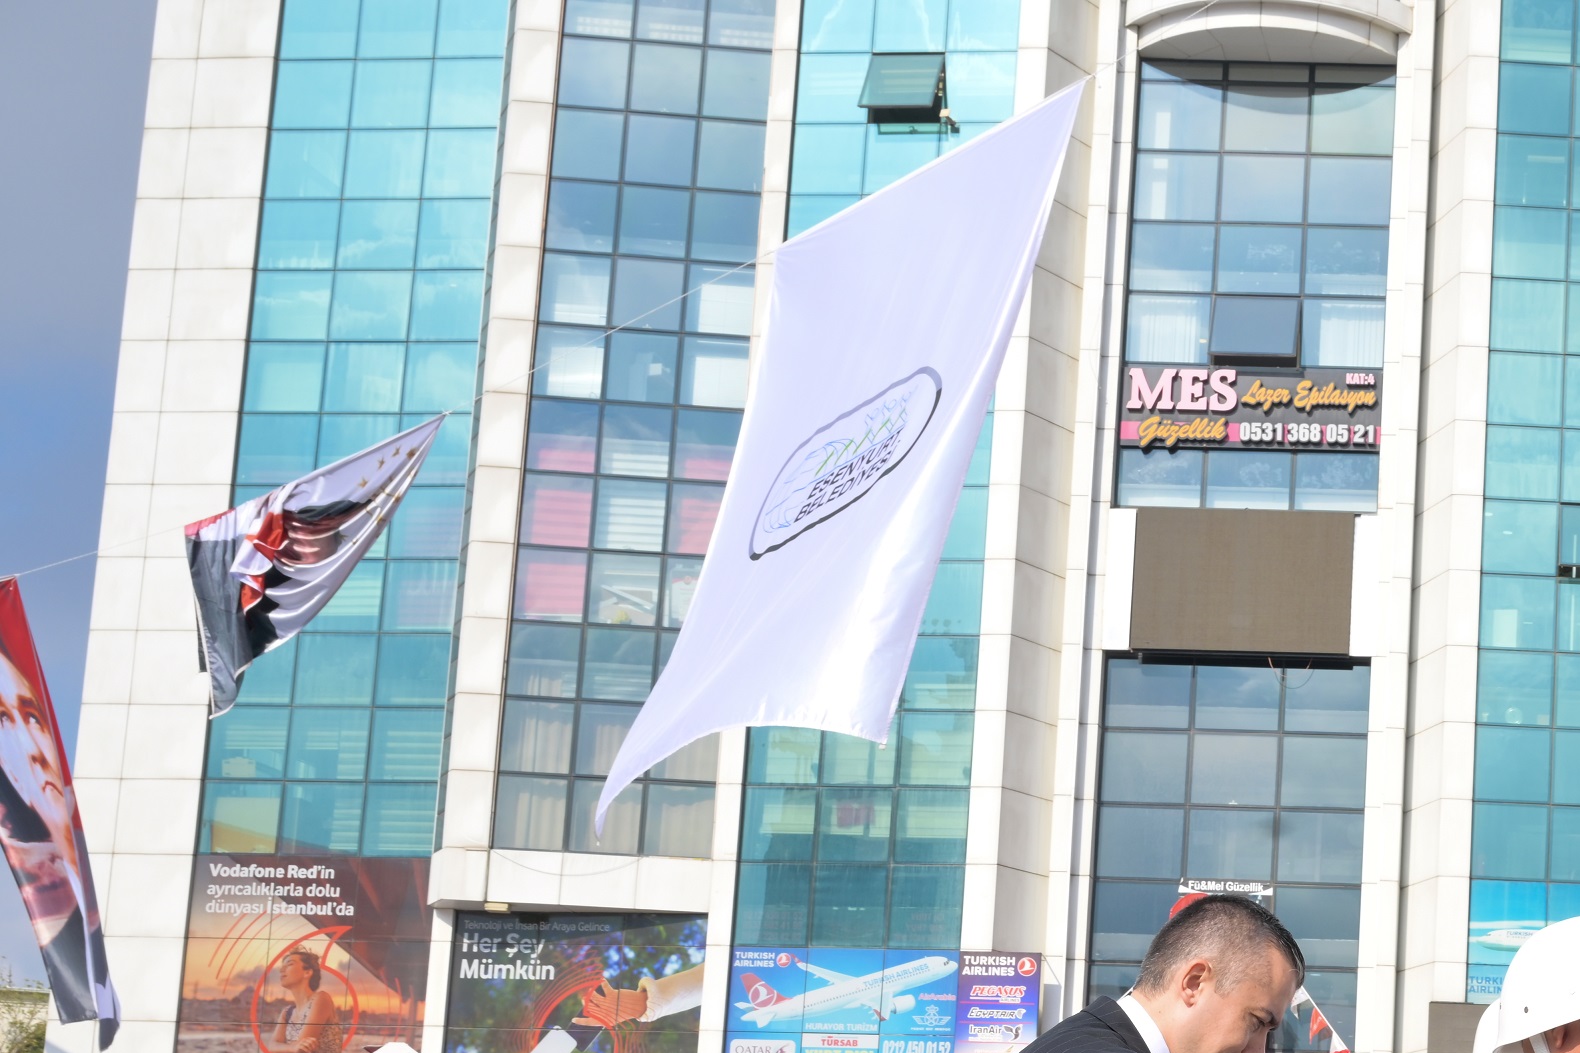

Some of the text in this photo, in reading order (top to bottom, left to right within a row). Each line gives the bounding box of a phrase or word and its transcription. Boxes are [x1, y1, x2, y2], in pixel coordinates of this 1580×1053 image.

[1345, 373, 1375, 385] KAT:4
[1126, 367, 1238, 411] MES
[1242, 380, 1376, 413] Lazer Epilasyon
[1138, 416, 1228, 447] Güzellik
[1239, 422, 1375, 444] 0531 368 05 21
[807, 427, 904, 501] ESENYURT
[209, 863, 285, 878] Vodafone
[207, 882, 341, 899] ayrıcalıklarla dolu
[1188, 880, 1264, 892] Fü&Mel Güzellik
[205, 899, 264, 917] dünyası
[464, 919, 610, 932] Teknoloji ve İnsan Bir Araya Gelince
[462, 932, 545, 958] Her Şey
[735, 951, 775, 960] TURKISH
[963, 956, 1016, 966] TURKISH
[459, 959, 555, 980] Mümkün
[734, 959, 775, 968] AIRLINES
[896, 963, 929, 978] AIRLINES
[962, 966, 1015, 976] AIRLINES
[1468, 976, 1503, 985] TURKI
[970, 986, 1026, 997] PEGASUS
[1468, 985, 1502, 994] AIRLIN
[968, 1007, 1016, 1018] EGYPTAIR
[846, 1022, 878, 1032] TURİZM
[969, 1025, 1003, 1035] IranAir
[821, 1036, 858, 1047] TÜRSAB
